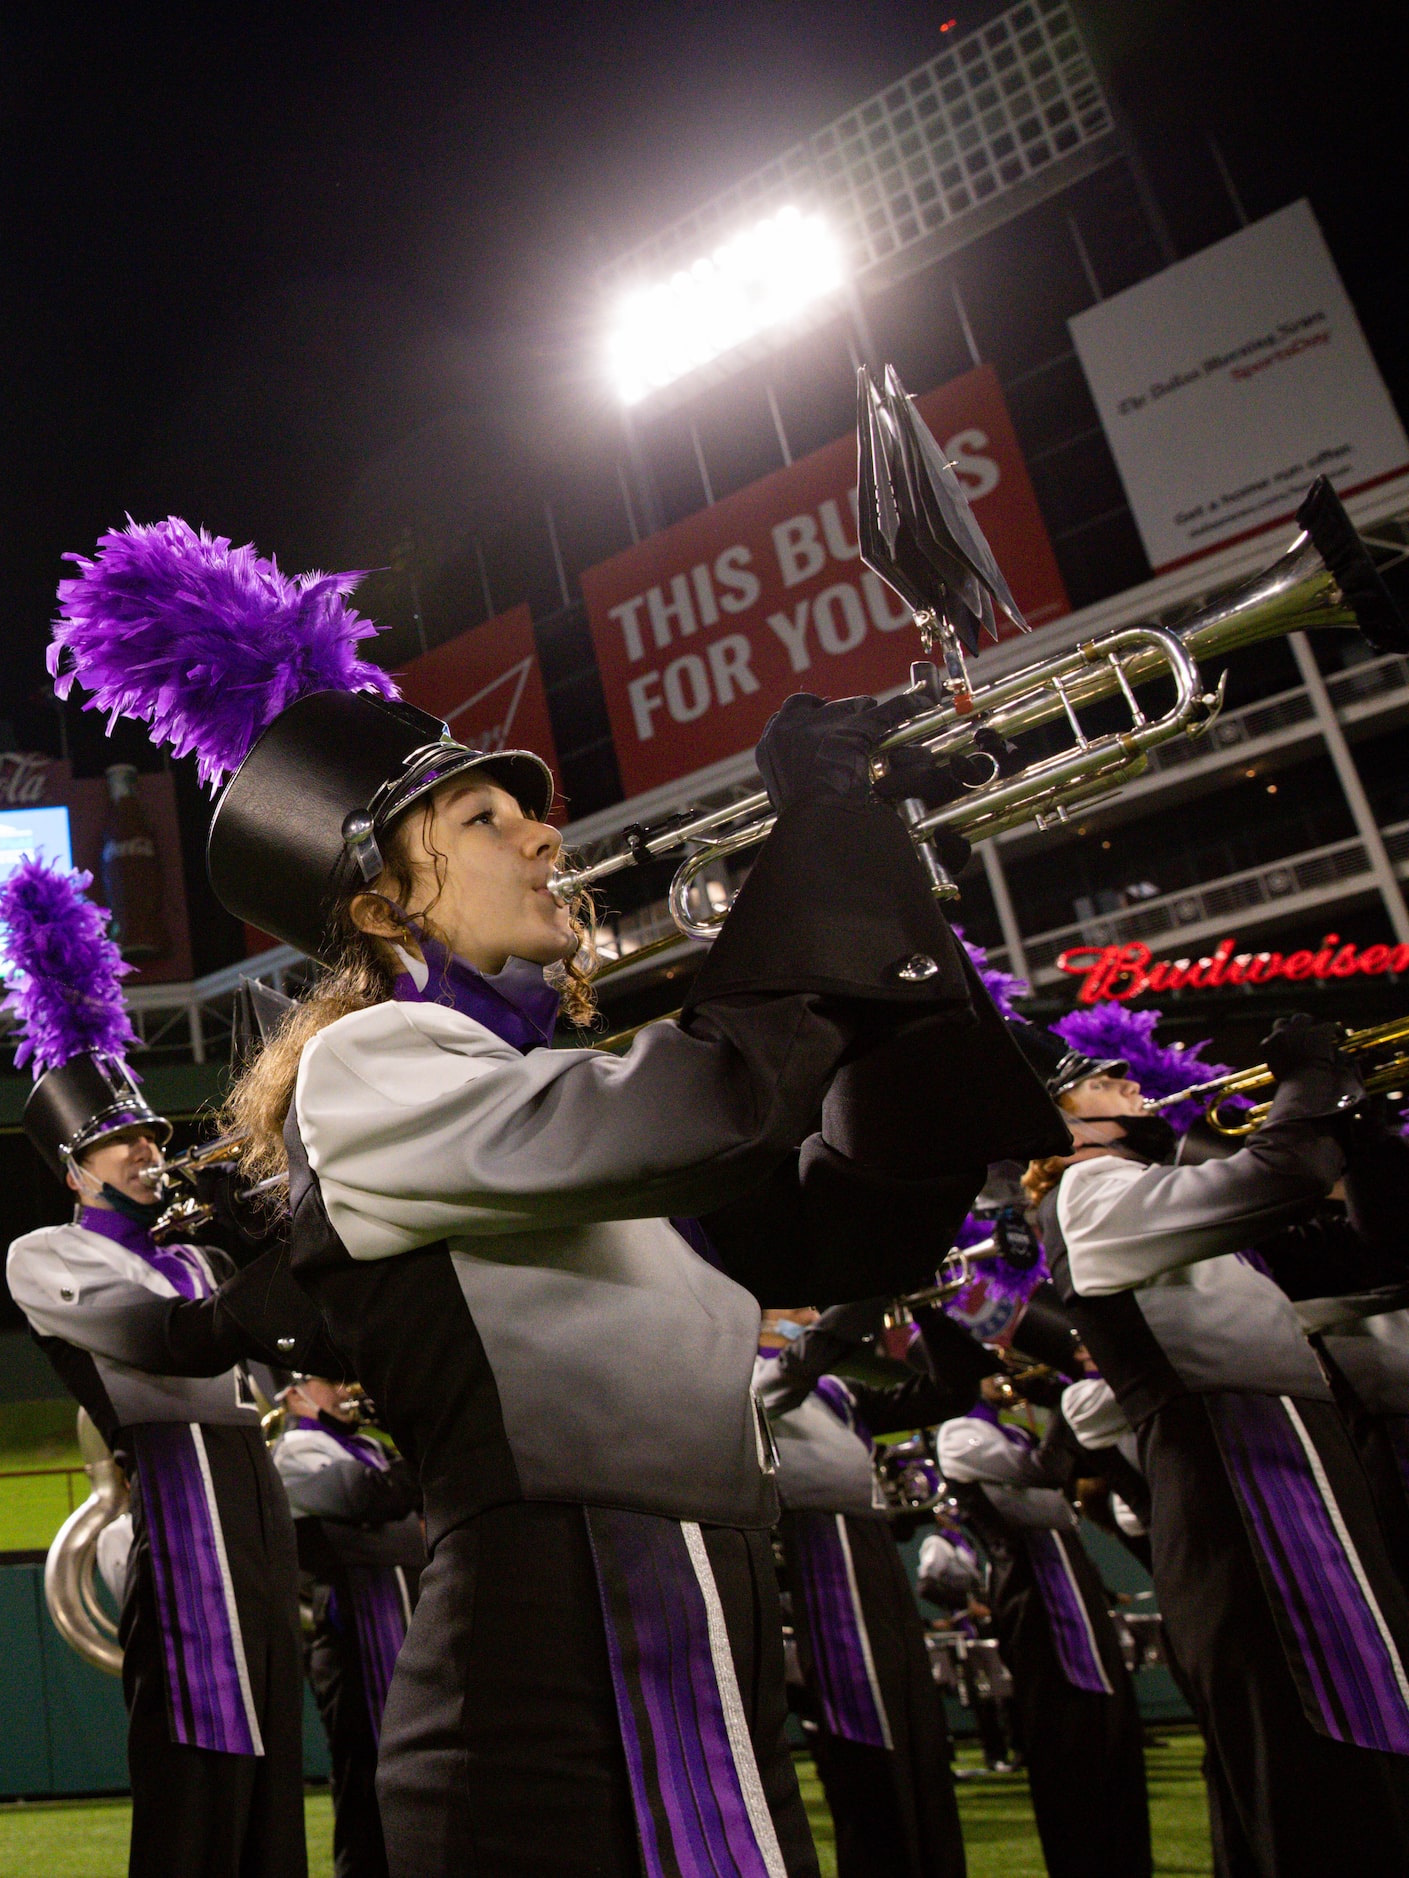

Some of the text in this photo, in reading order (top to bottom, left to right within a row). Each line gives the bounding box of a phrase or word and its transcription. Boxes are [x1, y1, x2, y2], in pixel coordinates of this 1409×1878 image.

[608, 428, 1002, 664] THIS BUS
[627, 569, 917, 742] FOR YOU
[1056, 932, 1409, 1005] Budweiser
